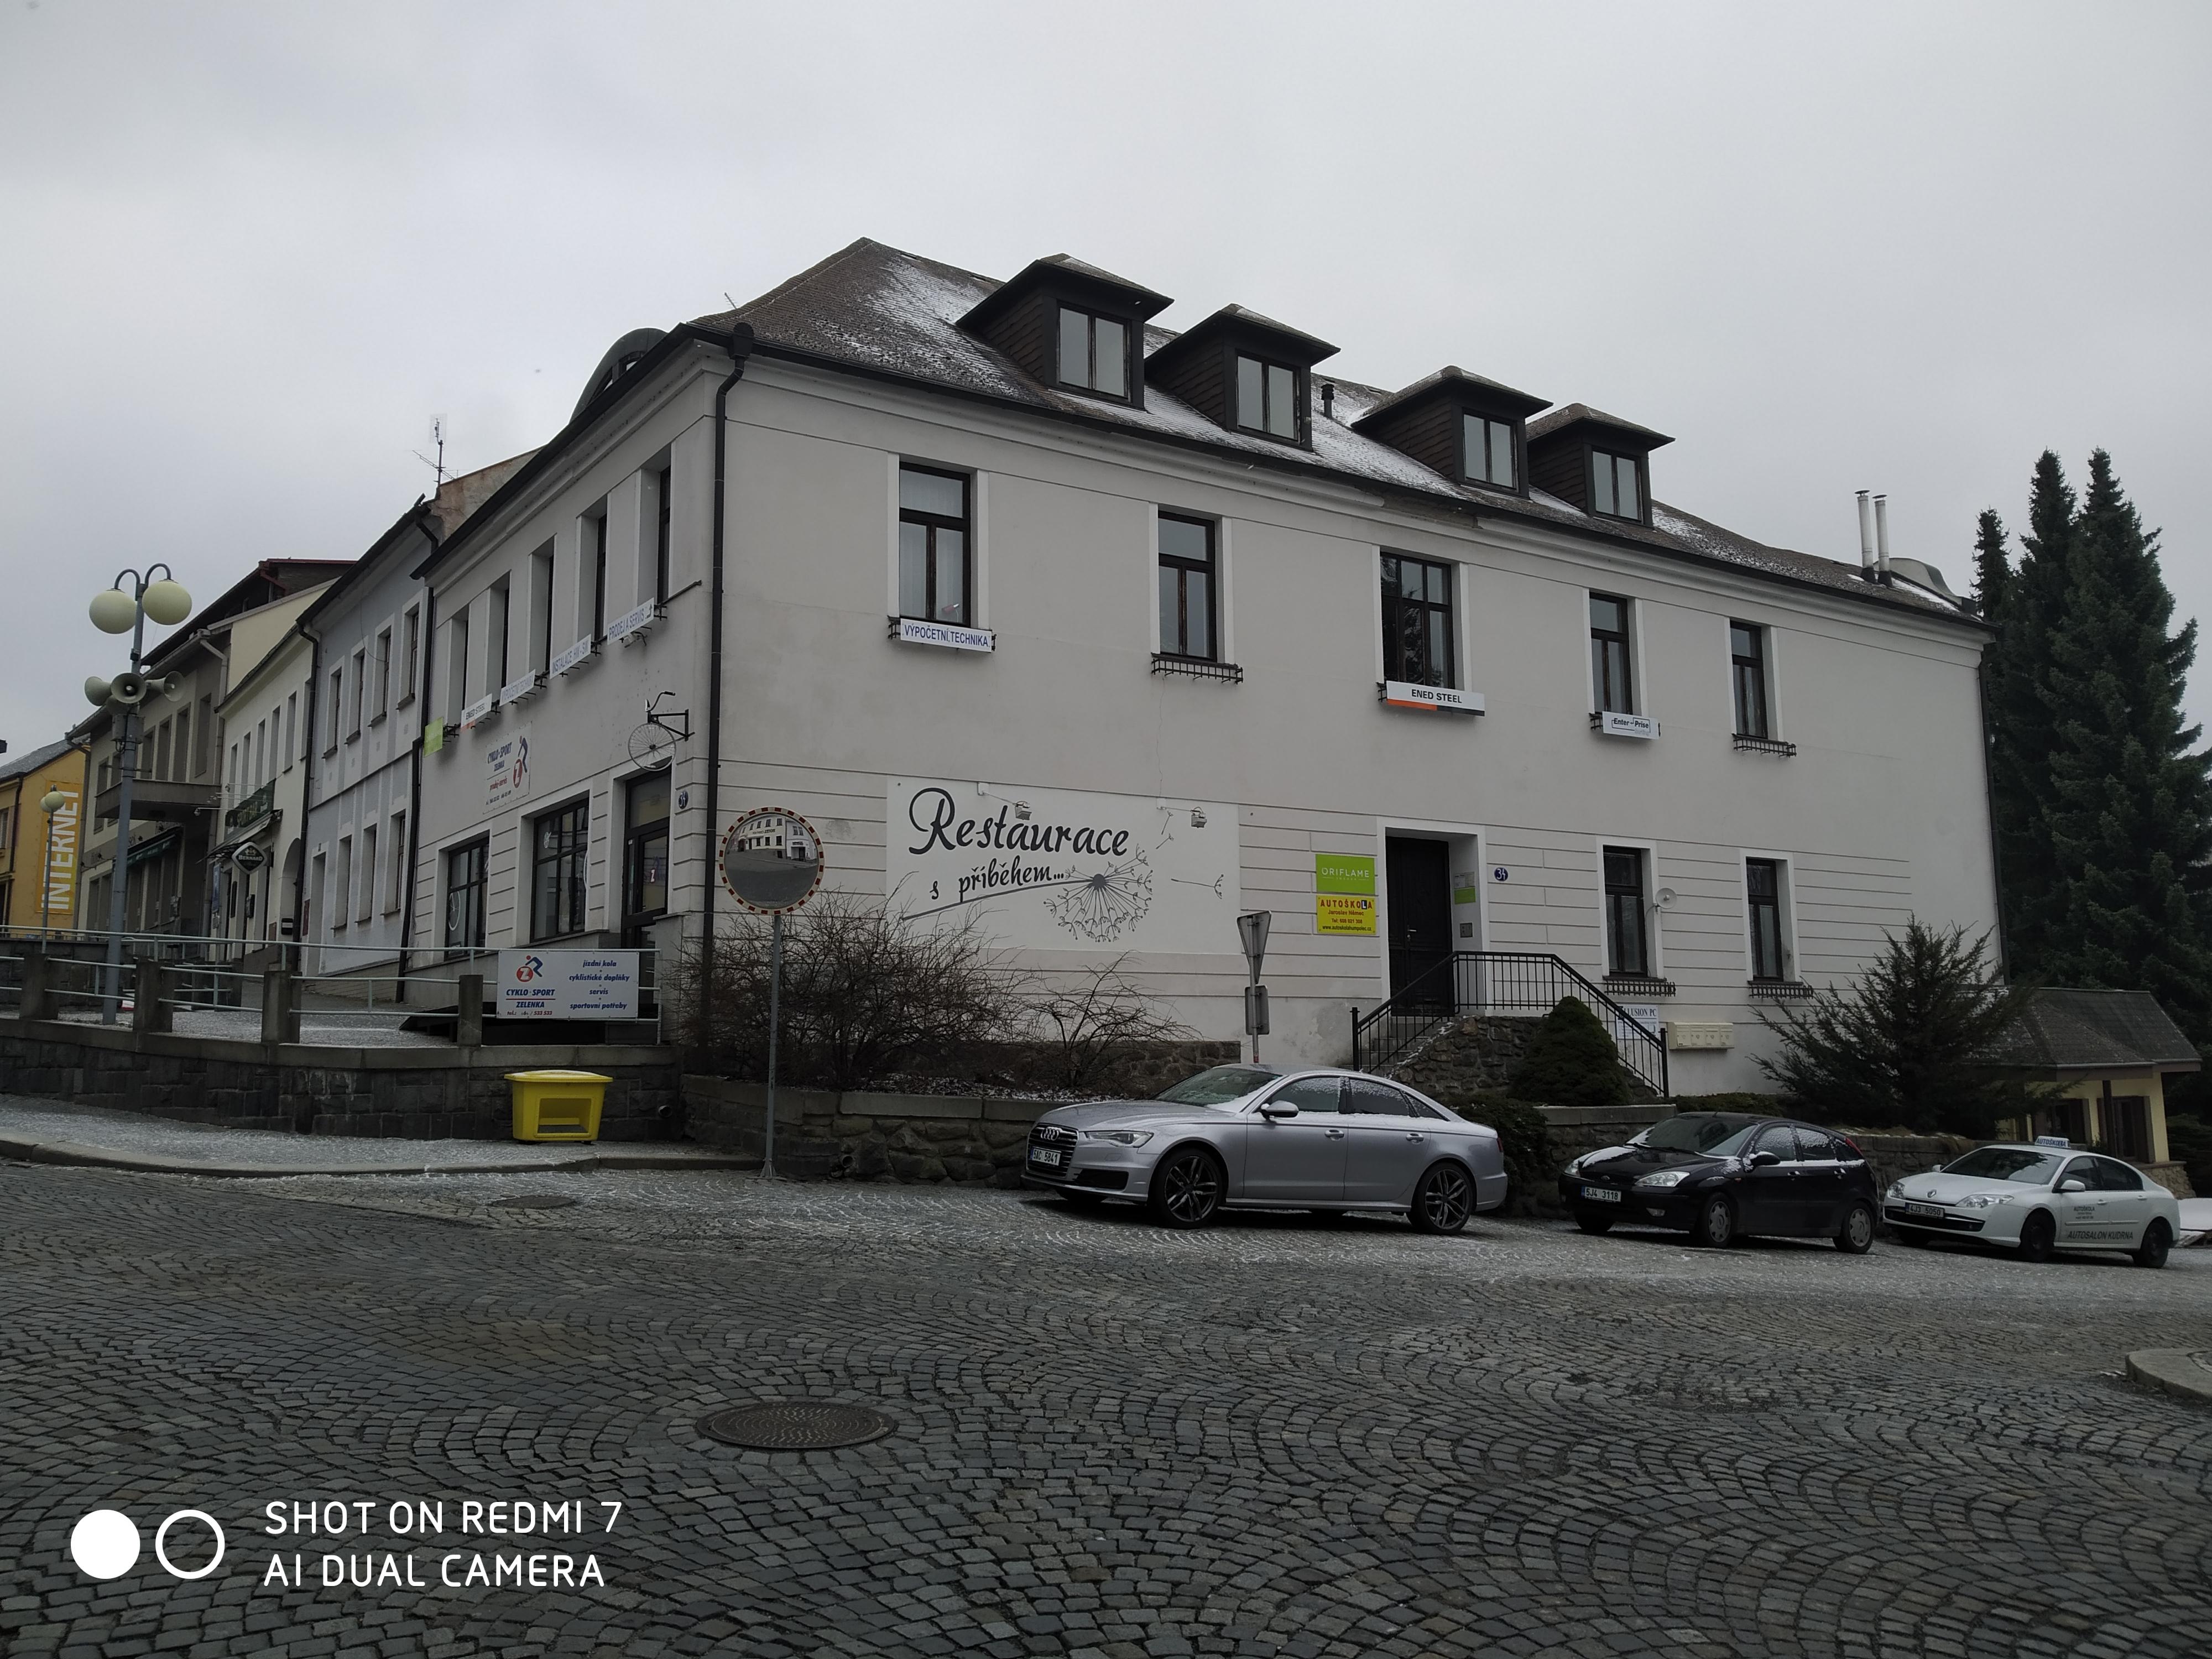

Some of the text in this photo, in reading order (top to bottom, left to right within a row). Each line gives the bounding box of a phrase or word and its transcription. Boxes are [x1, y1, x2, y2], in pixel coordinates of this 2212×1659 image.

[609, 608, 645, 640] PRODEJ A SERVIS
[904, 623, 988, 647] VÝPOČETNÍ TECHNIKA
[552, 651, 572, 674] INSTALACE
[1411, 688, 1463, 704] ENED STEEL
[466, 703, 485, 720] ENED STEEL
[909, 787, 1129, 855] Restaurace
[930, 855, 1065, 902] s příběhem...
[1321, 868, 1370, 878] ORIFLAME
[1496, 868, 1506, 880] 34
[1320, 899, 1373, 910] AUTOŠKOLA
[601, 1001, 627, 1010] potřeby
[1650, 1008, 1657, 1016] PC
[2036, 1139, 2066, 1147] AUTOŠKOLA
[1033, 1150, 1057, 1164] 5AC 5841
[1586, 1188, 1598, 1197] 5J4
[1602, 1191, 1619, 1200] 3118
[1925, 1207, 1941, 1215] 5050
[2067, 1231, 2133, 1240] AUTOSALON KUDRNA
